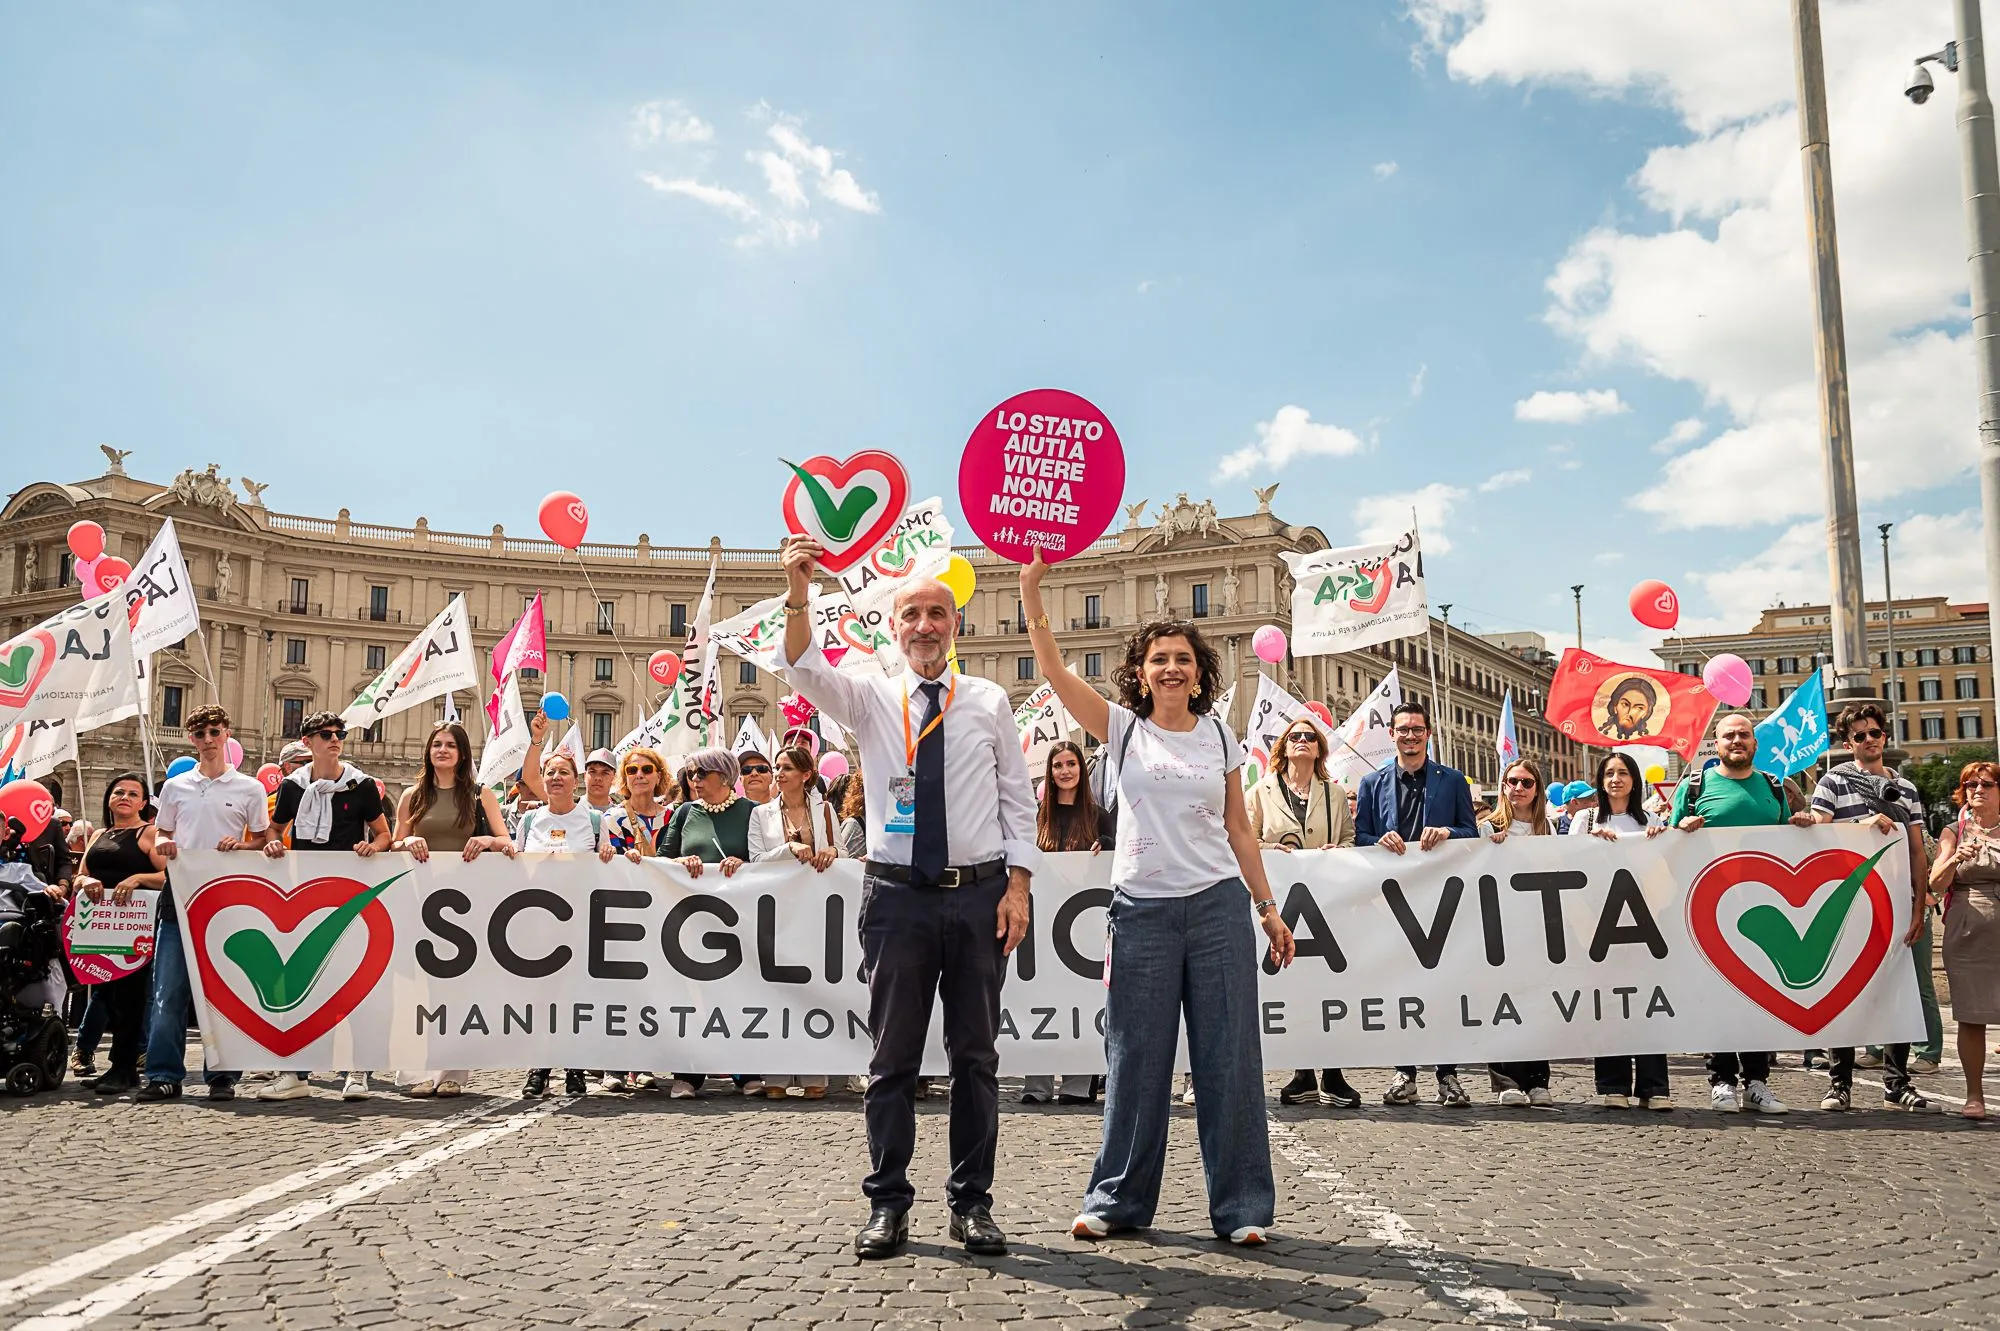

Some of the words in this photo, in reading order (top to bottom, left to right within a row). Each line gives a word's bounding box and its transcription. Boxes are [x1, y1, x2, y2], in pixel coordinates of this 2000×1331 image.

[996, 410, 1027, 431] LO
[1028, 414, 1103, 441] STATO
[1004, 433, 1065, 459] AIUTI
[1067, 441, 1085, 461] A
[1003, 453, 1086, 483] VIVERE
[1002, 475, 1054, 500] NON
[1055, 483, 1073, 502] A
[989, 494, 1080, 525] MORIRE
[1025, 529, 1066, 544] PROVITA
[842, 565, 878, 596] LA
[1801, 616, 1815, 625] LE
[92, 911, 111, 919] PER
[119, 911, 148, 920] DIRITTI
[130, 900, 147, 908] VITA
[91, 922, 111, 931] PER
[113, 922, 124, 931] LE
[126, 923, 153, 932] DONNE
[1381, 868, 1669, 970] VITA
[416, 1003, 876, 1041] MANIFESTAZION
[1322, 996, 1426, 1033] PER
[1461, 992, 1523, 1027] LA
[1552, 985, 1676, 1023] VITA
